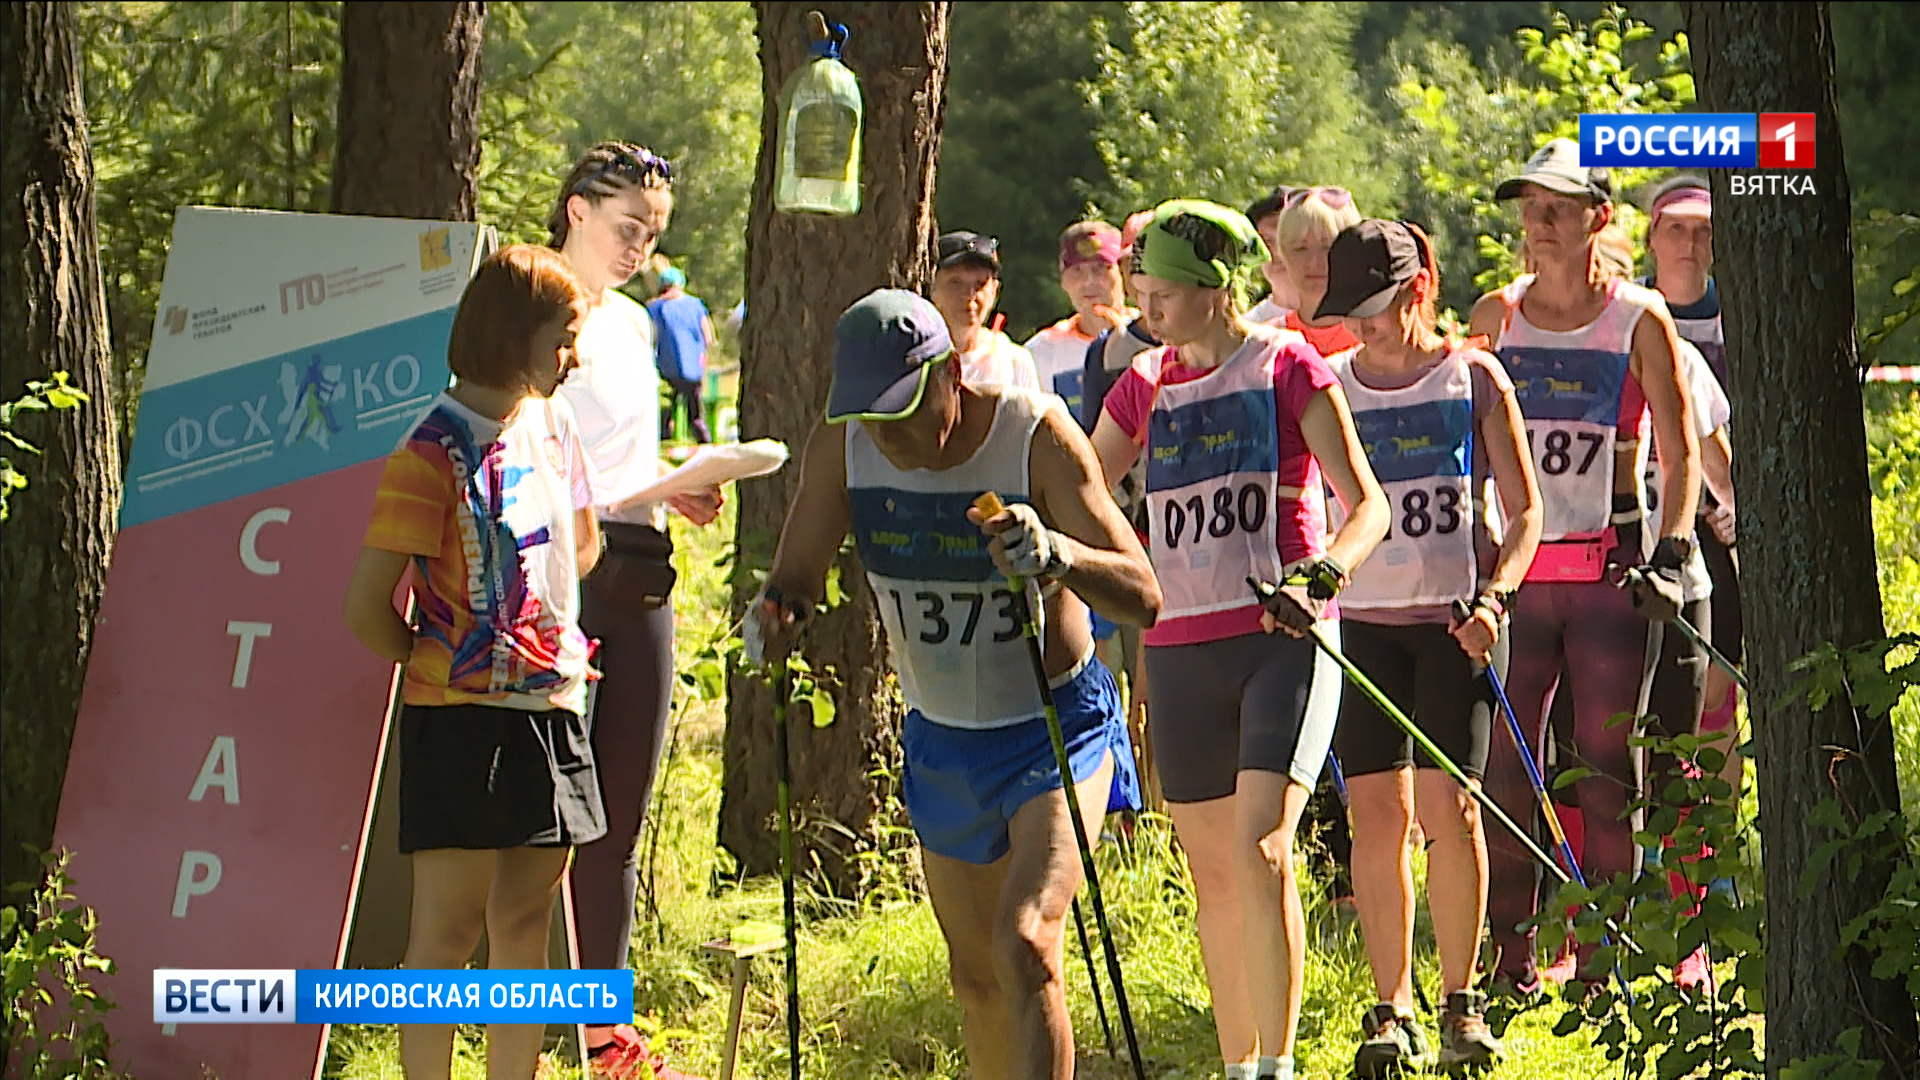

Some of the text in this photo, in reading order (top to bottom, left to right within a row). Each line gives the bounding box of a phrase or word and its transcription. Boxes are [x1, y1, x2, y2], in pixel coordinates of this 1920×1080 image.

[164, 354, 421, 460] ФСХ КО
[1165, 482, 1267, 549] 0180
[1383, 485, 1460, 541] 83
[890, 589, 1024, 646] 1373
